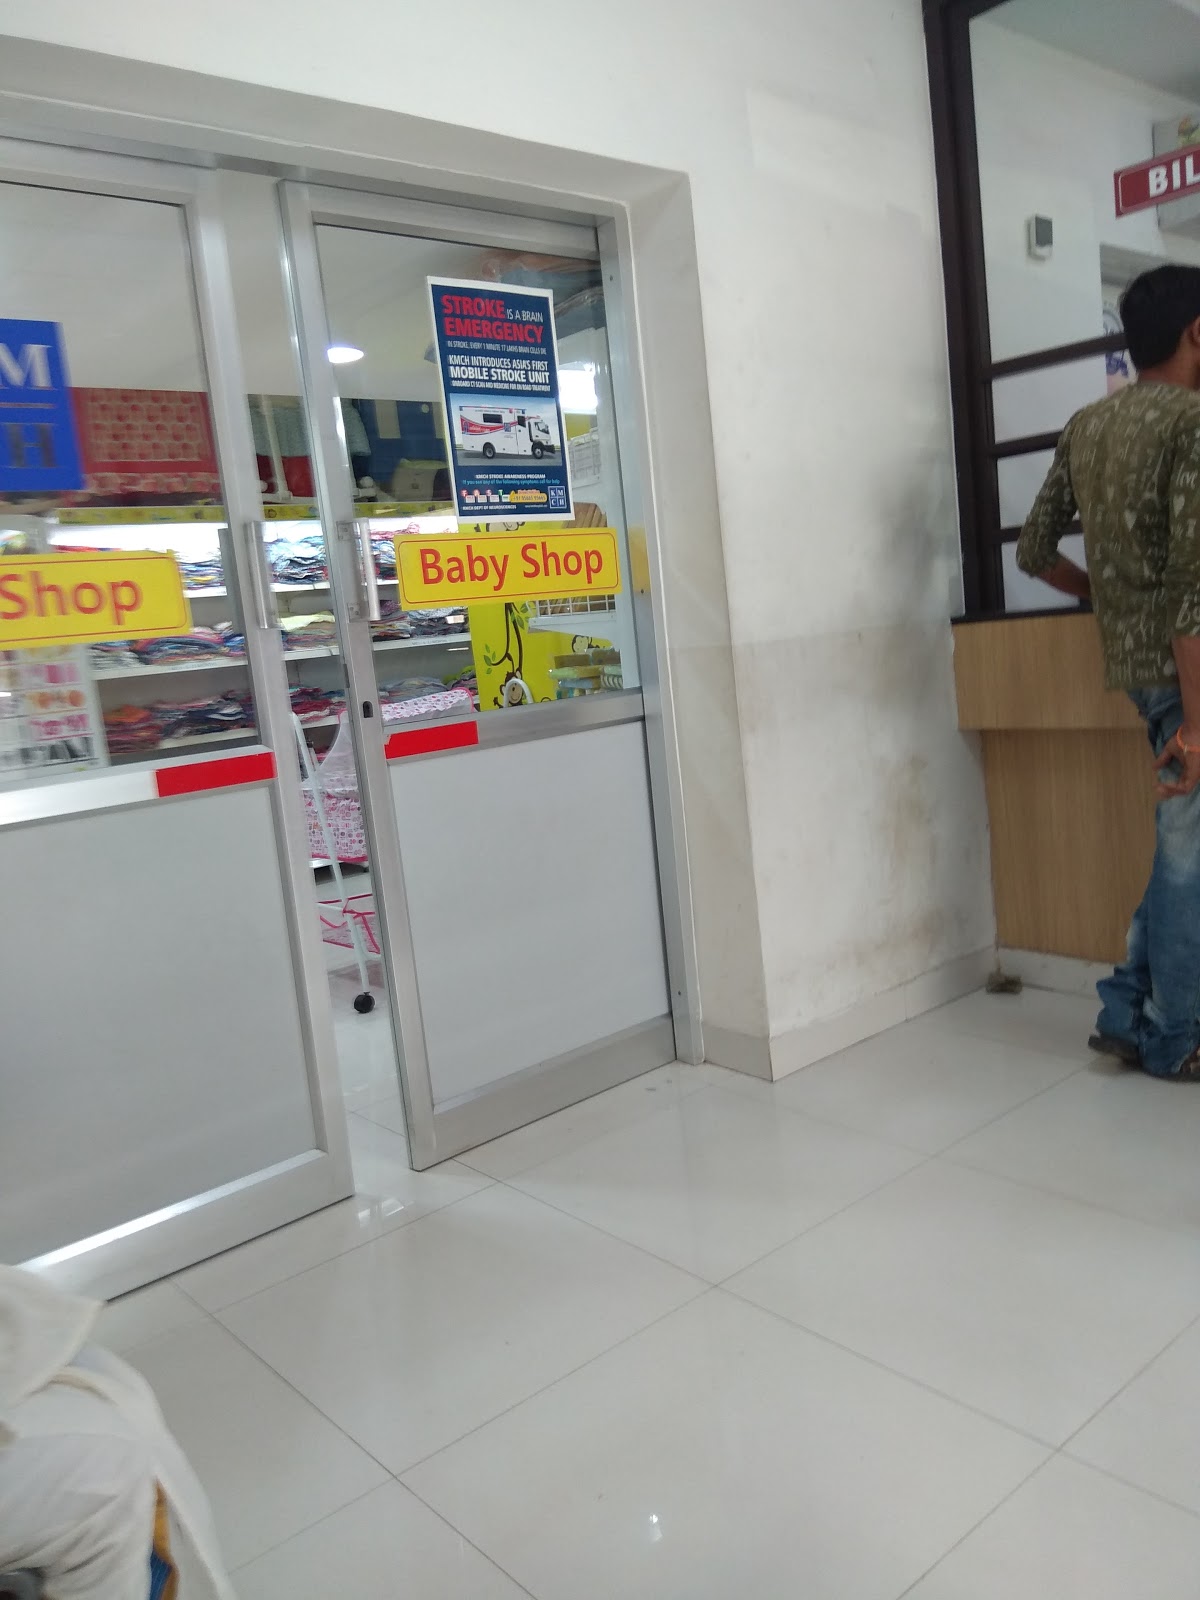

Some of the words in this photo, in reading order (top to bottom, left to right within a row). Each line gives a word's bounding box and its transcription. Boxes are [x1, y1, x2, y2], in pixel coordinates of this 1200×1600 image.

[1148, 154, 1200, 199] BIL
[441, 294, 506, 319] STROKE
[506, 308, 514, 320] IS
[515, 309, 521, 320] A
[522, 310, 544, 323] BRAIN
[443, 317, 544, 344] EMERGENCY
[449, 354, 470, 366] KMCH
[471, 356, 512, 369] INTRODUCES
[532, 360, 548, 371] FIRST
[450, 366, 489, 380] MOBILE
[491, 368, 527, 383] STROKE
[528, 371, 549, 384] UNIT
[419, 544, 510, 592] Baby
[520, 541, 604, 585] Shop
[0, 569, 144, 626] Shop
